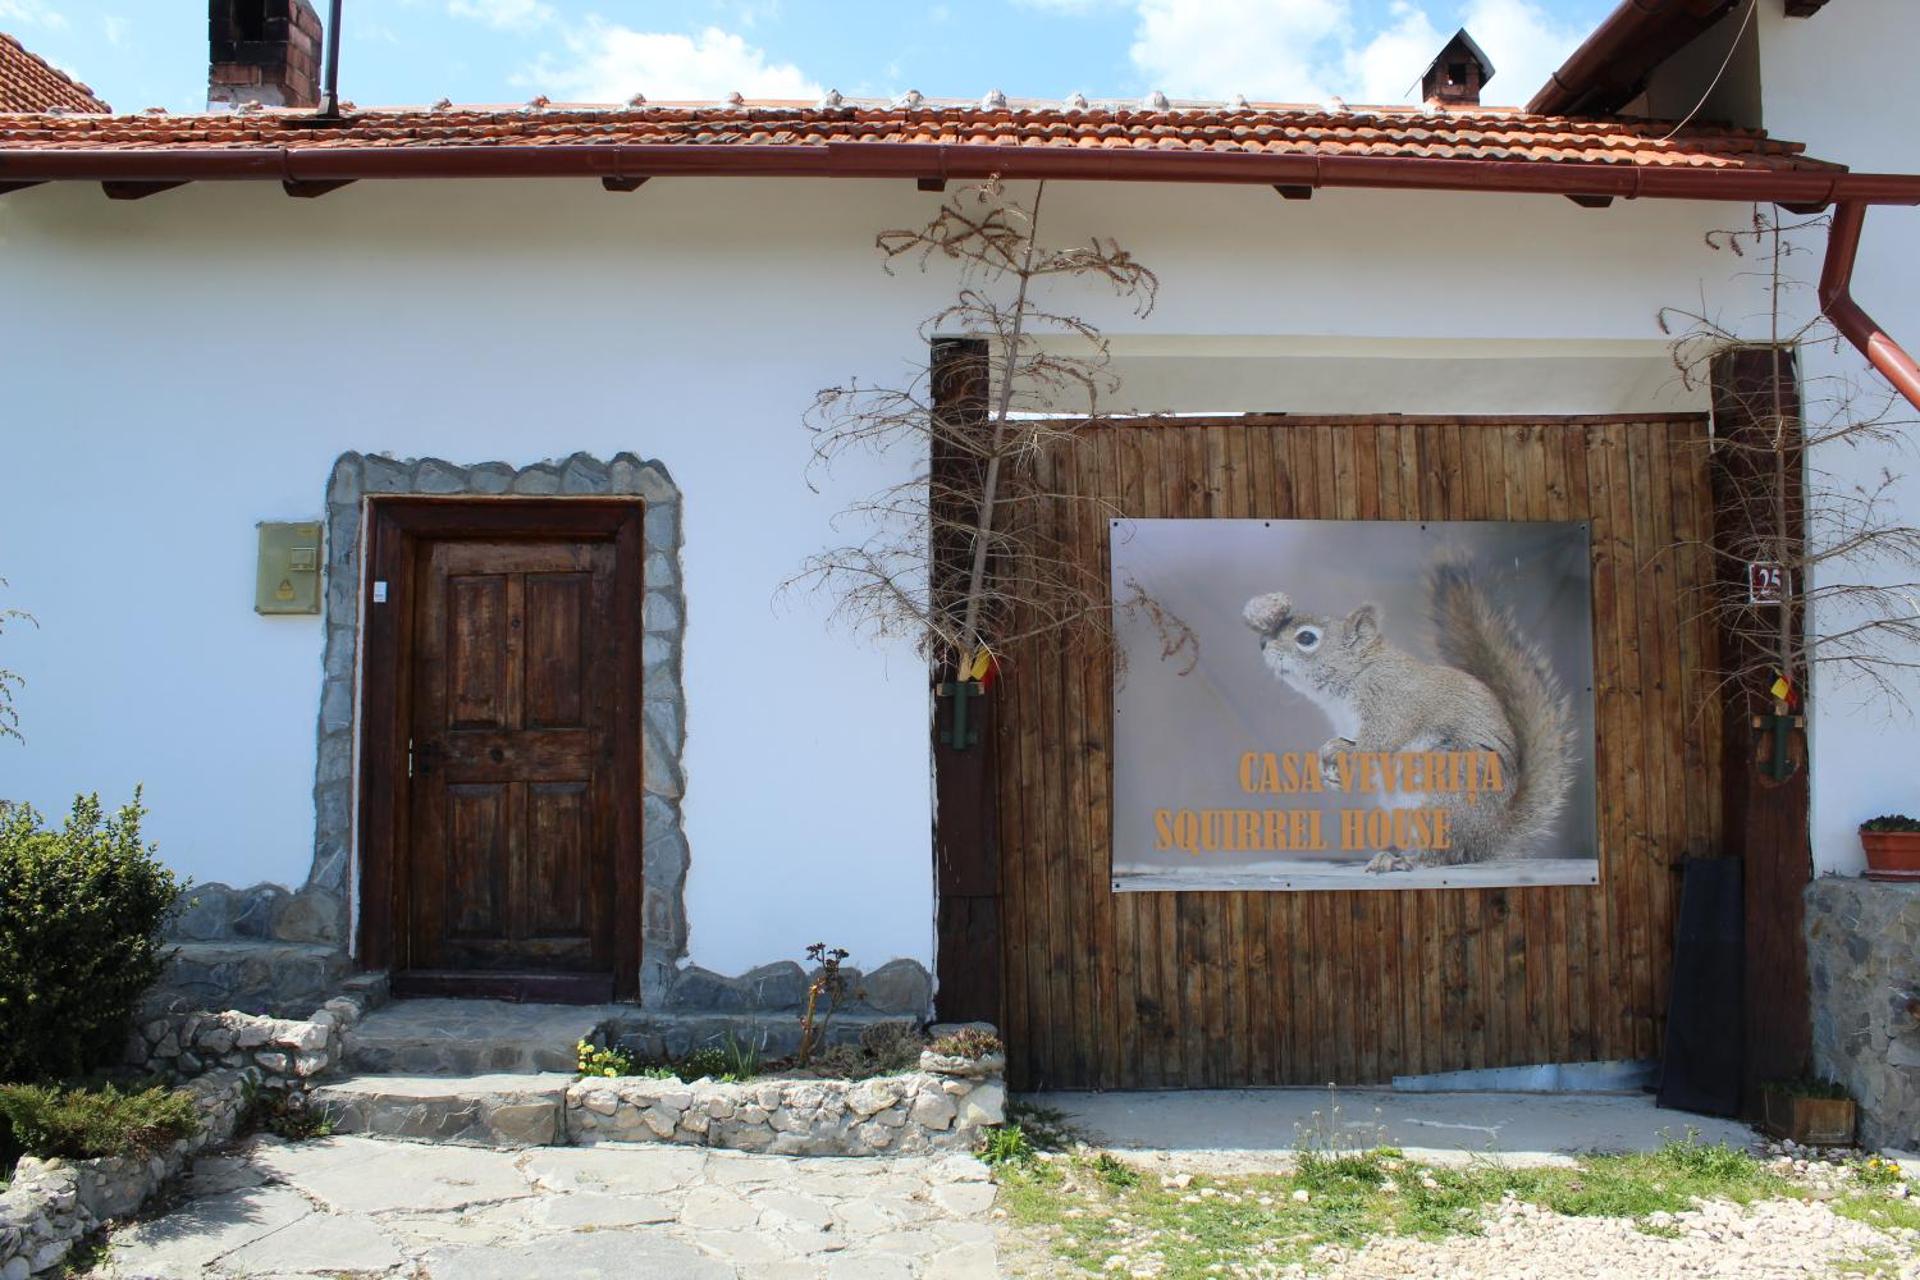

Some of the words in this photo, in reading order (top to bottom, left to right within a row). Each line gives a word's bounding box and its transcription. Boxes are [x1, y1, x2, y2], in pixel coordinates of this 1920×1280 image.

[1759, 568, 1782, 595] 25
[1239, 751, 1323, 793] CASA
[1154, 807, 1328, 855] SQUIRREL
[1341, 807, 1452, 850] HOUSE
